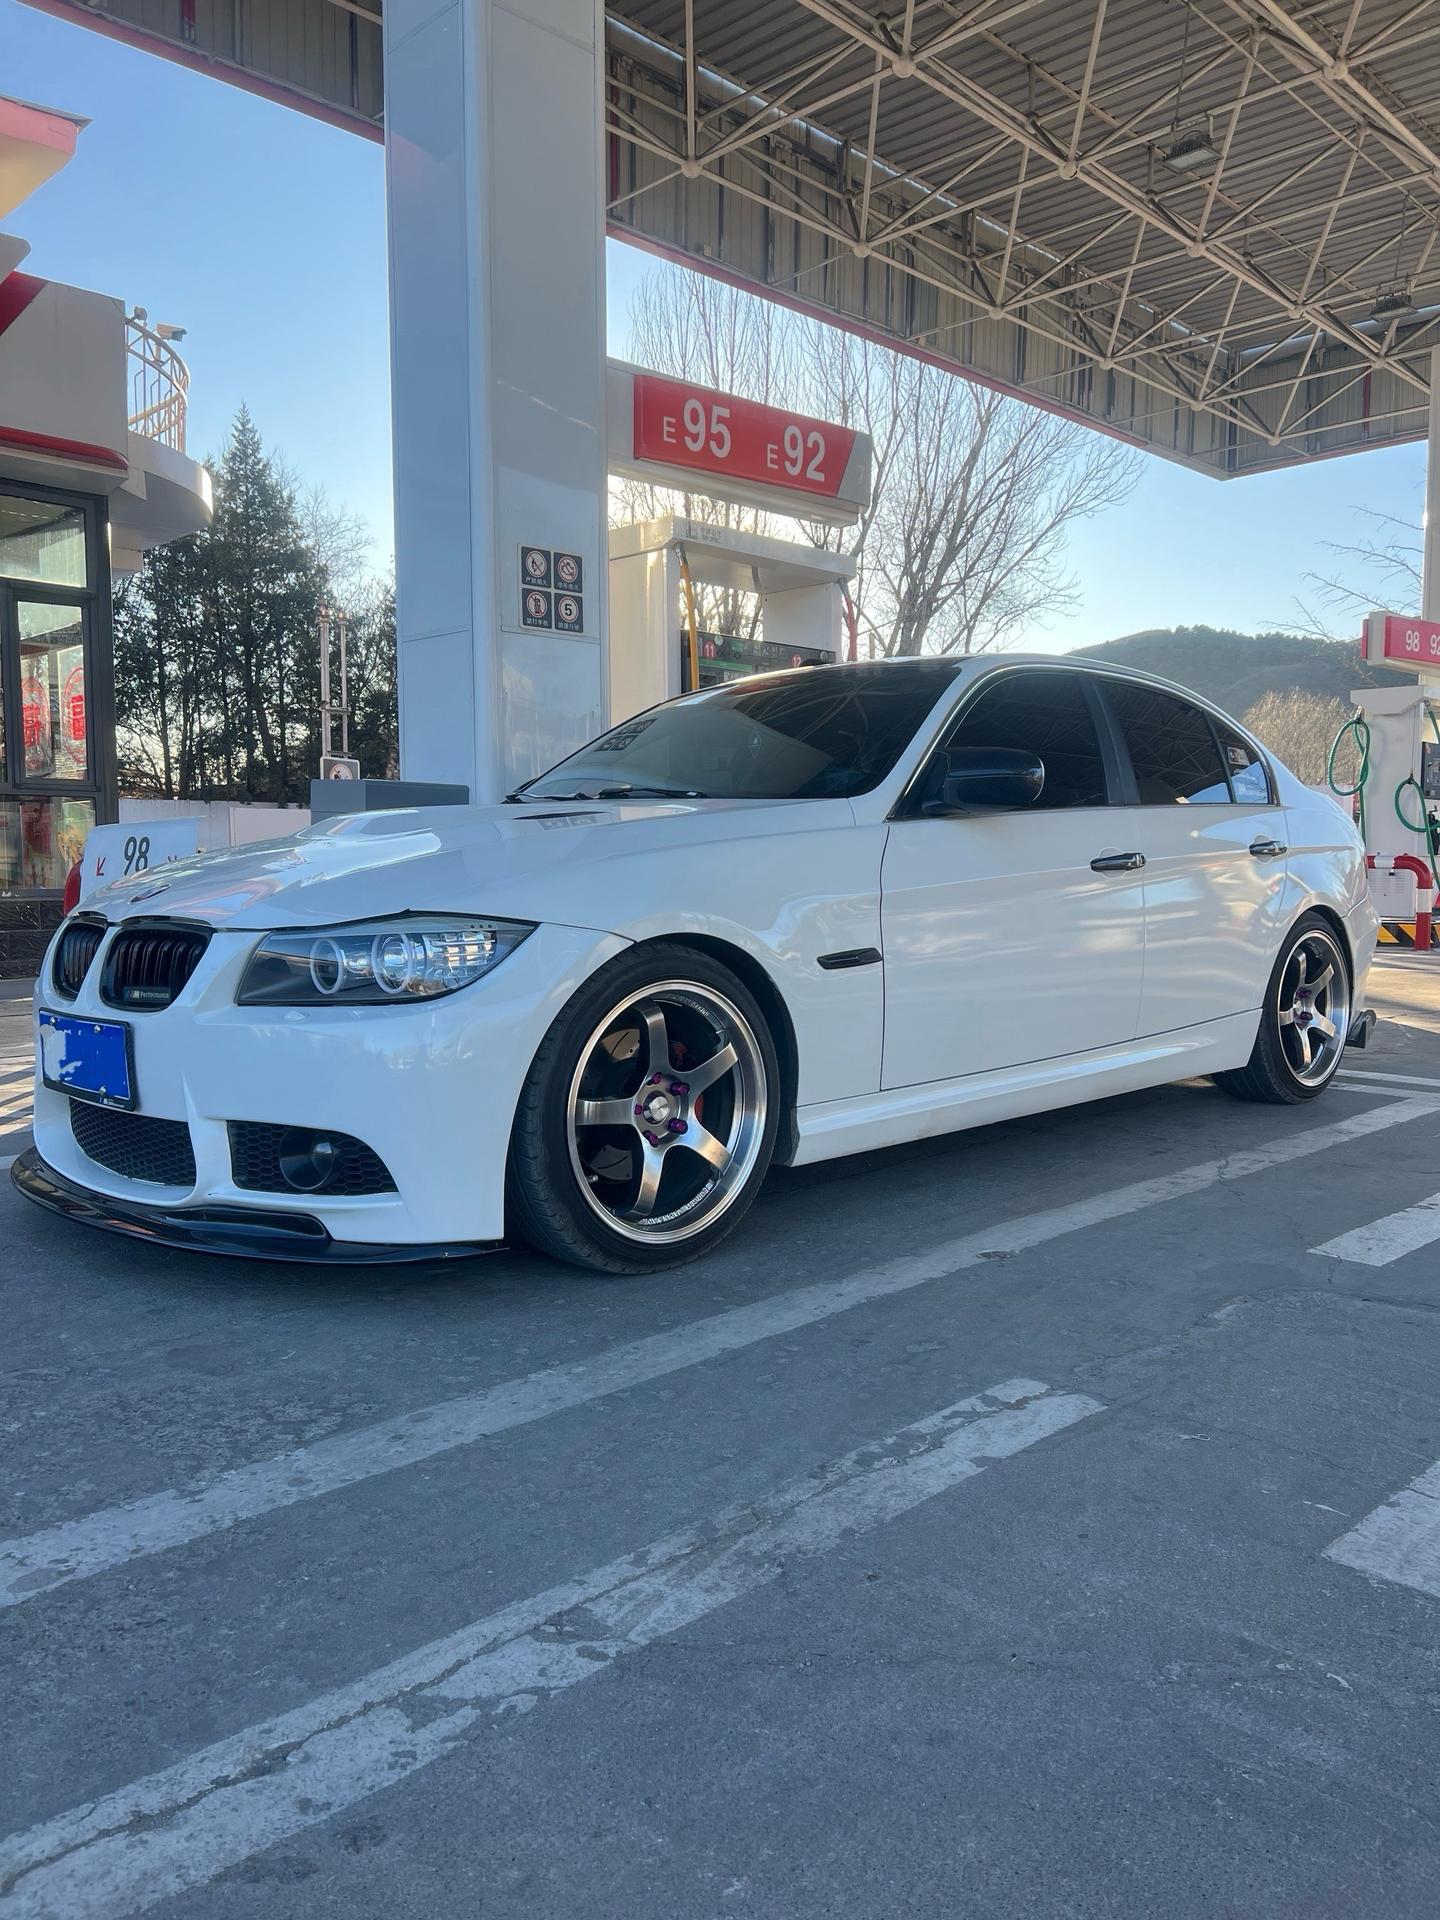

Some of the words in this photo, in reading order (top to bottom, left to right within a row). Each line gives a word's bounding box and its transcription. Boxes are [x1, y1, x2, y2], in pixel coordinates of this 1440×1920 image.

[565, 604, 573, 616] 5
[1406, 631, 1420, 652] 98
[704, 644, 715, 658] 11
[793, 655, 802, 668] 12
[123, 836, 150, 876] 98
